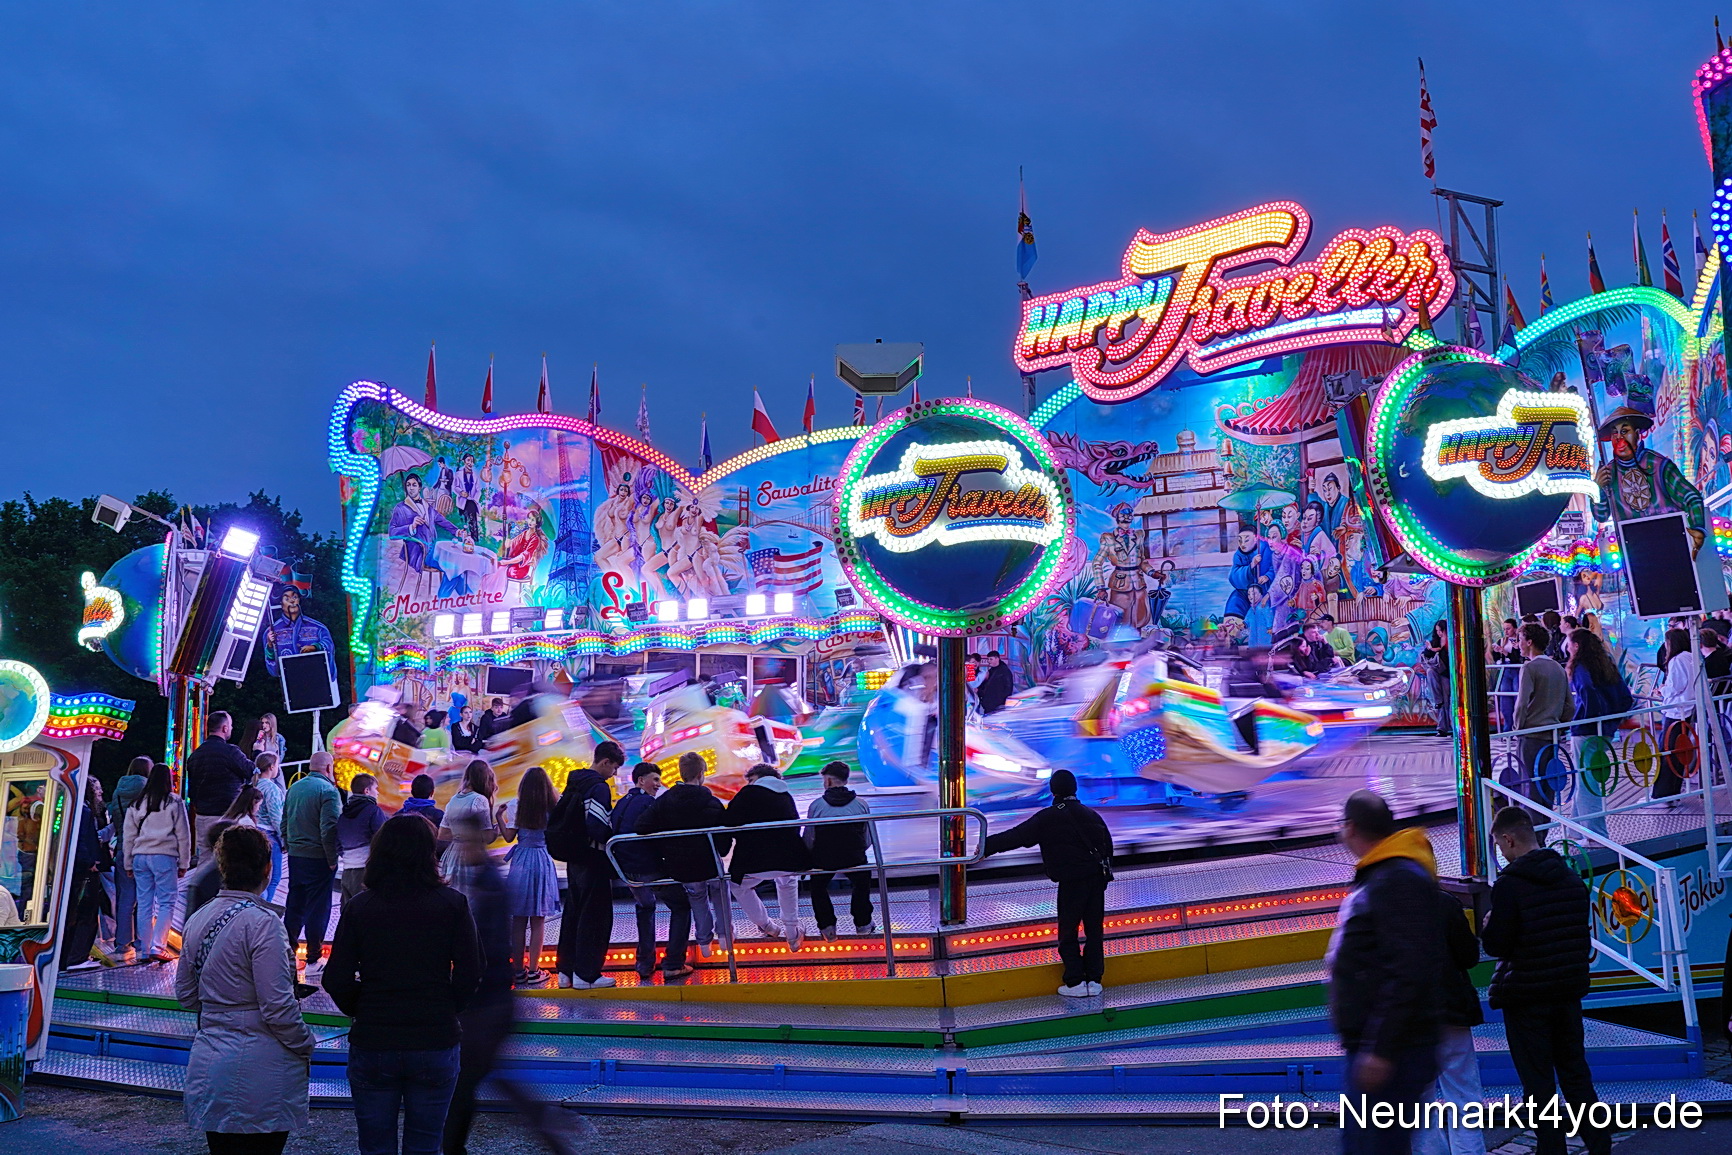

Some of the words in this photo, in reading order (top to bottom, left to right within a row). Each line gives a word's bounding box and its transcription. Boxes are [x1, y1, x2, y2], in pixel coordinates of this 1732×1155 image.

[1021, 277, 1172, 361] HAPPY
[1080, 211, 1440, 385] Traveller
[1438, 425, 1534, 470] HAPPY
[859, 477, 937, 523] HAPPY
[884, 453, 1053, 538] Traveller
[383, 589, 504, 623] Montmartre
